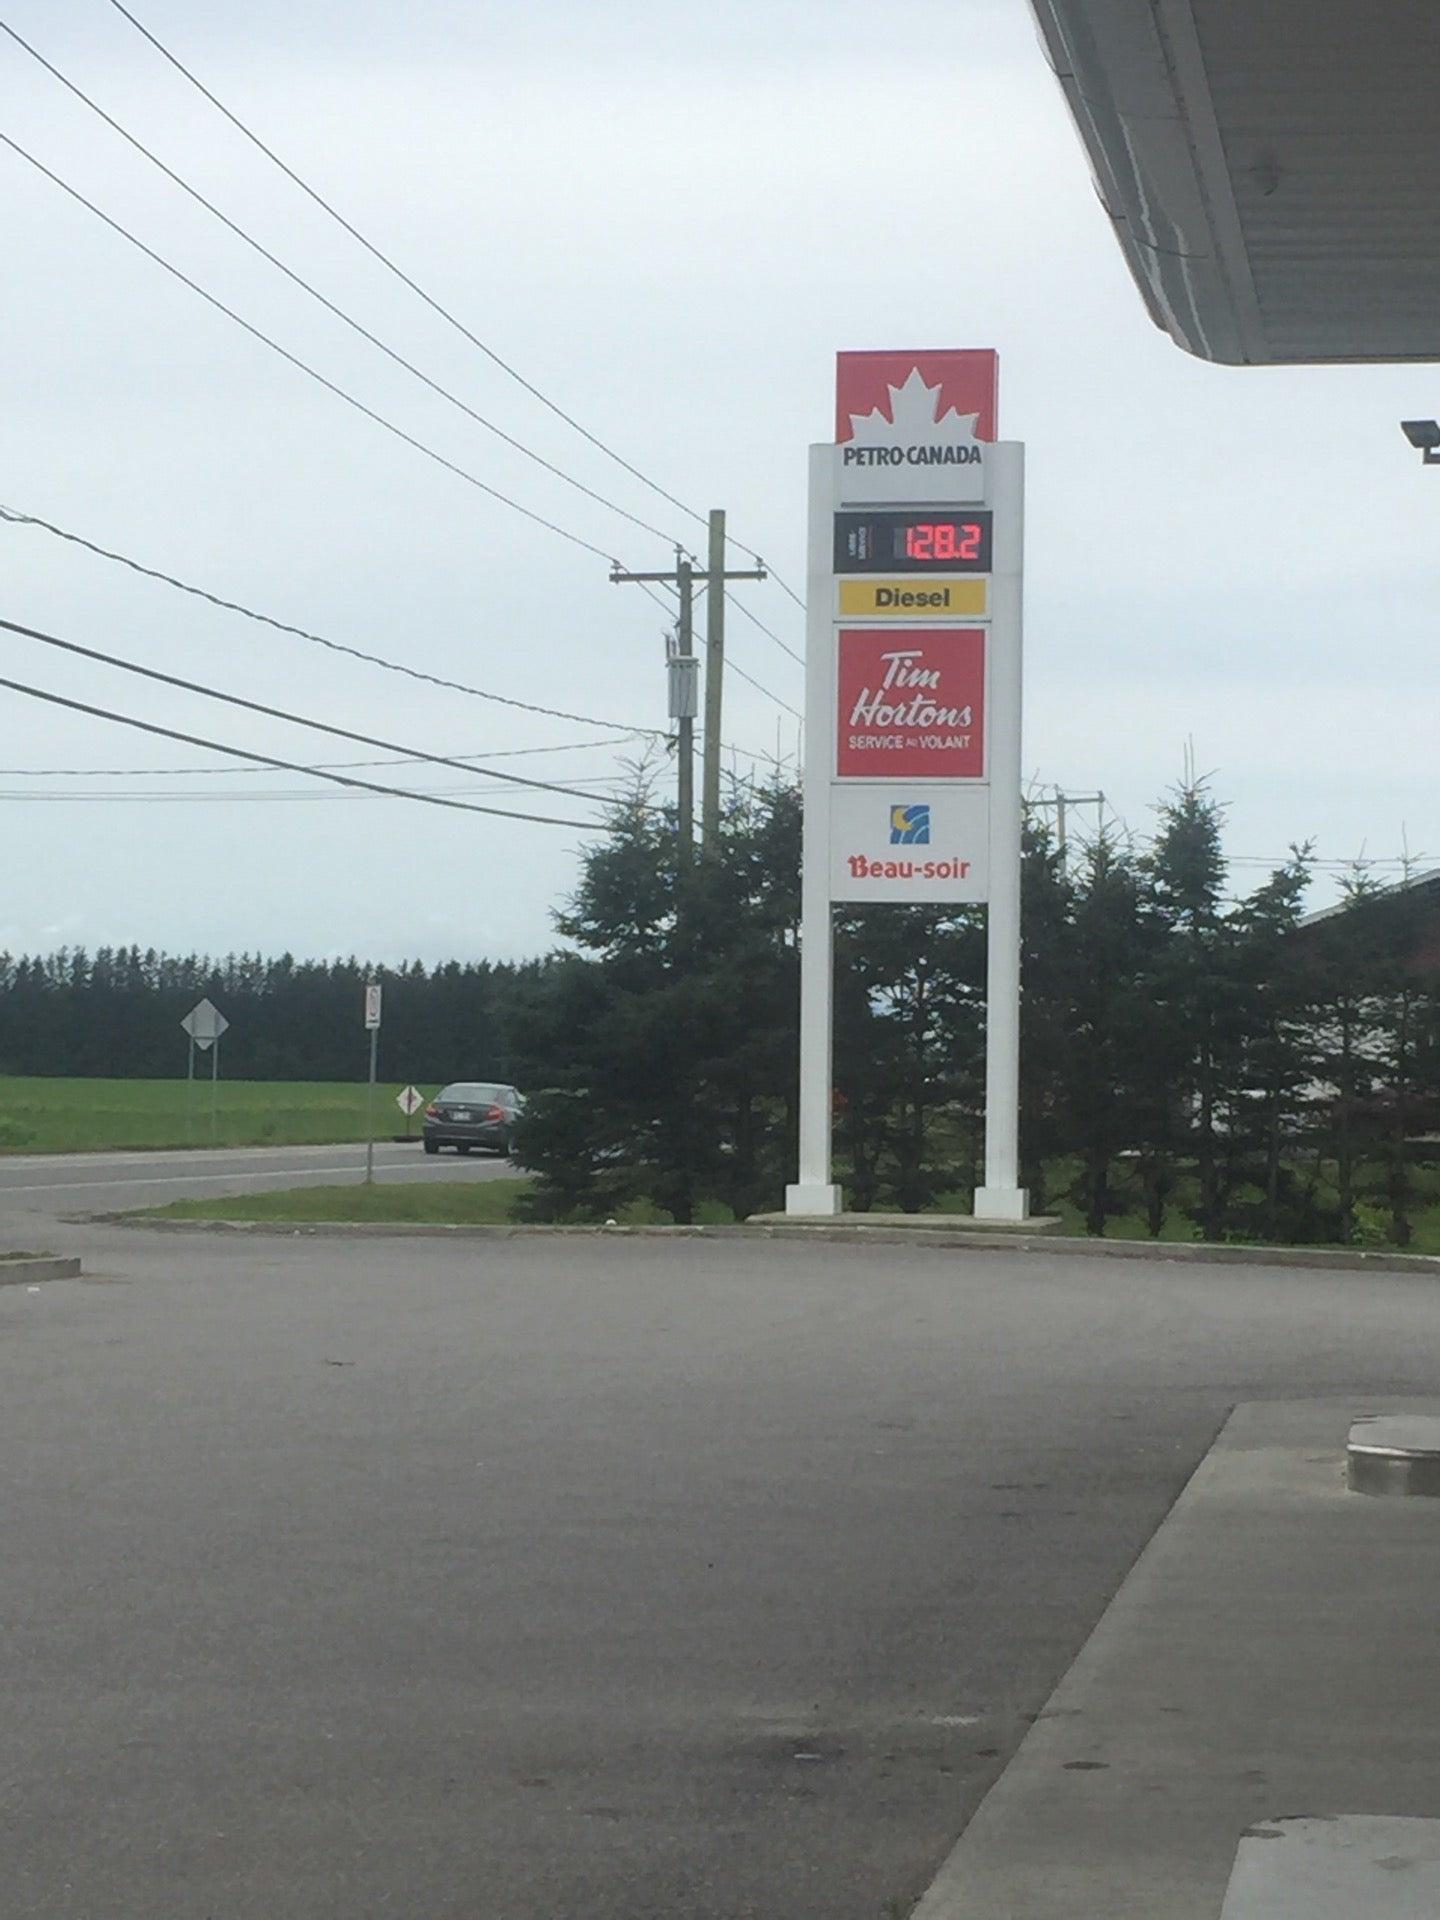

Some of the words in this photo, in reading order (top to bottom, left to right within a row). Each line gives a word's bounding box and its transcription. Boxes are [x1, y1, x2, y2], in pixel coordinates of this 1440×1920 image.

[906, 523, 982, 559] 128.2
[875, 588, 951, 607] Diesel
[881, 650, 941, 690] Tim
[849, 687, 972, 727] Hortons
[849, 735, 903, 750] SERVICE
[920, 735, 971, 749] VOLANT
[847, 855, 970, 879] Beau-soir
